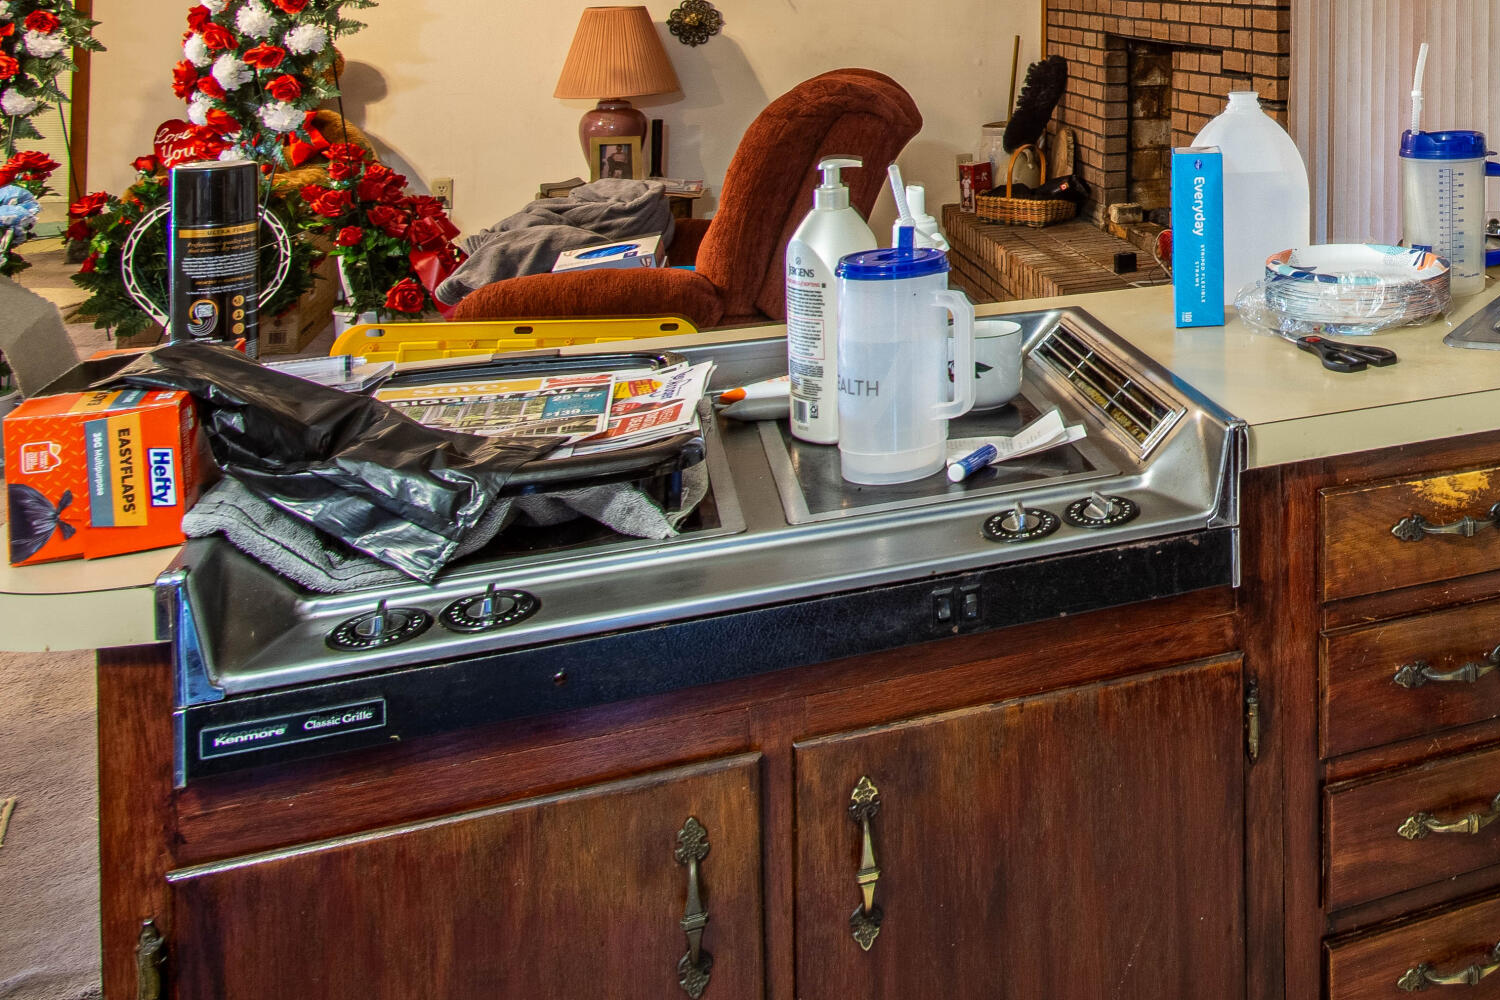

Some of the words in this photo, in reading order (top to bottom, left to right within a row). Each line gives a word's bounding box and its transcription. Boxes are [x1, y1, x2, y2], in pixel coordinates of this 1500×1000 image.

[154, 128, 192, 144] Love
[162, 145, 196, 167] You
[1192, 176, 1206, 236] Everyday
[389, 391, 520, 408] BIGGEST
[523, 387, 593, 398] SALE
[93, 449, 105, 496] Multipurpose
[118, 428, 137, 513] EASYFLAPS
[152, 451, 172, 504] Hefty
[213, 727, 287, 747] Kenmore
[303, 717, 341, 731] Classic
[342, 710, 373, 724] Grille
